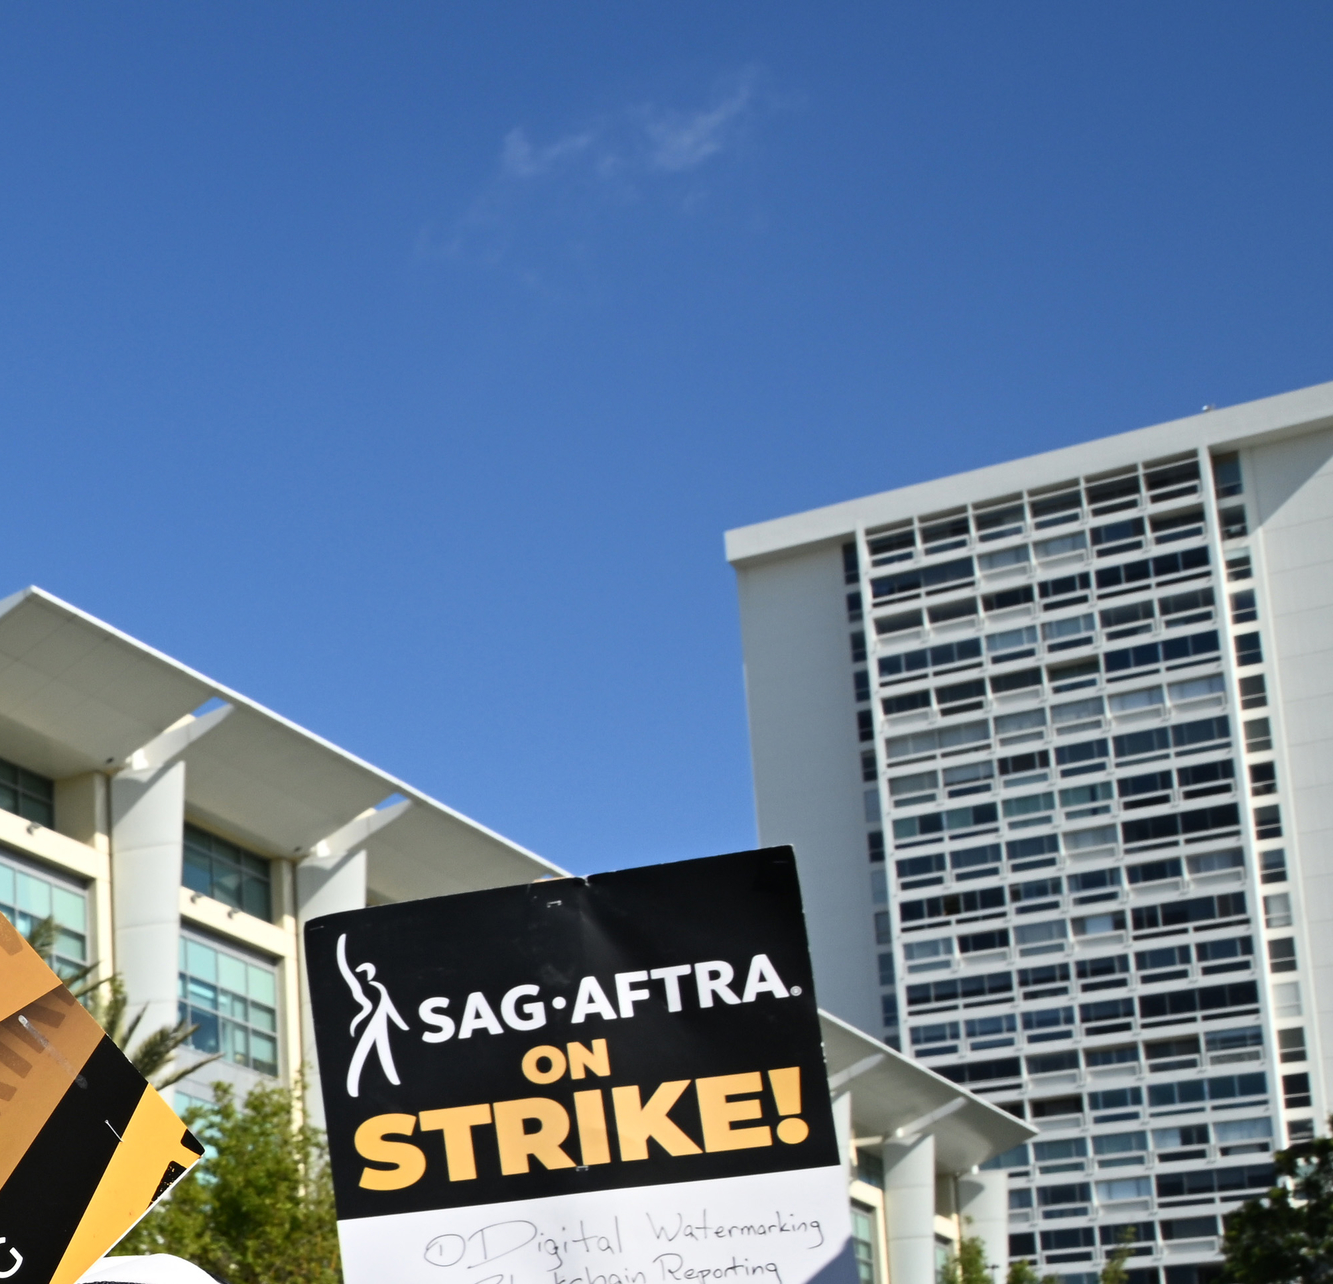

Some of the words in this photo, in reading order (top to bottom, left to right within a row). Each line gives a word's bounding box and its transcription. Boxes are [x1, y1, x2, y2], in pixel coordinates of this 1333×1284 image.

[520, 1038, 612, 1085] ON
[353, 1066, 810, 1192] STRIKE!
[467, 1215, 623, 1272] Digital
[645, 1208, 825, 1249] Watermarking
